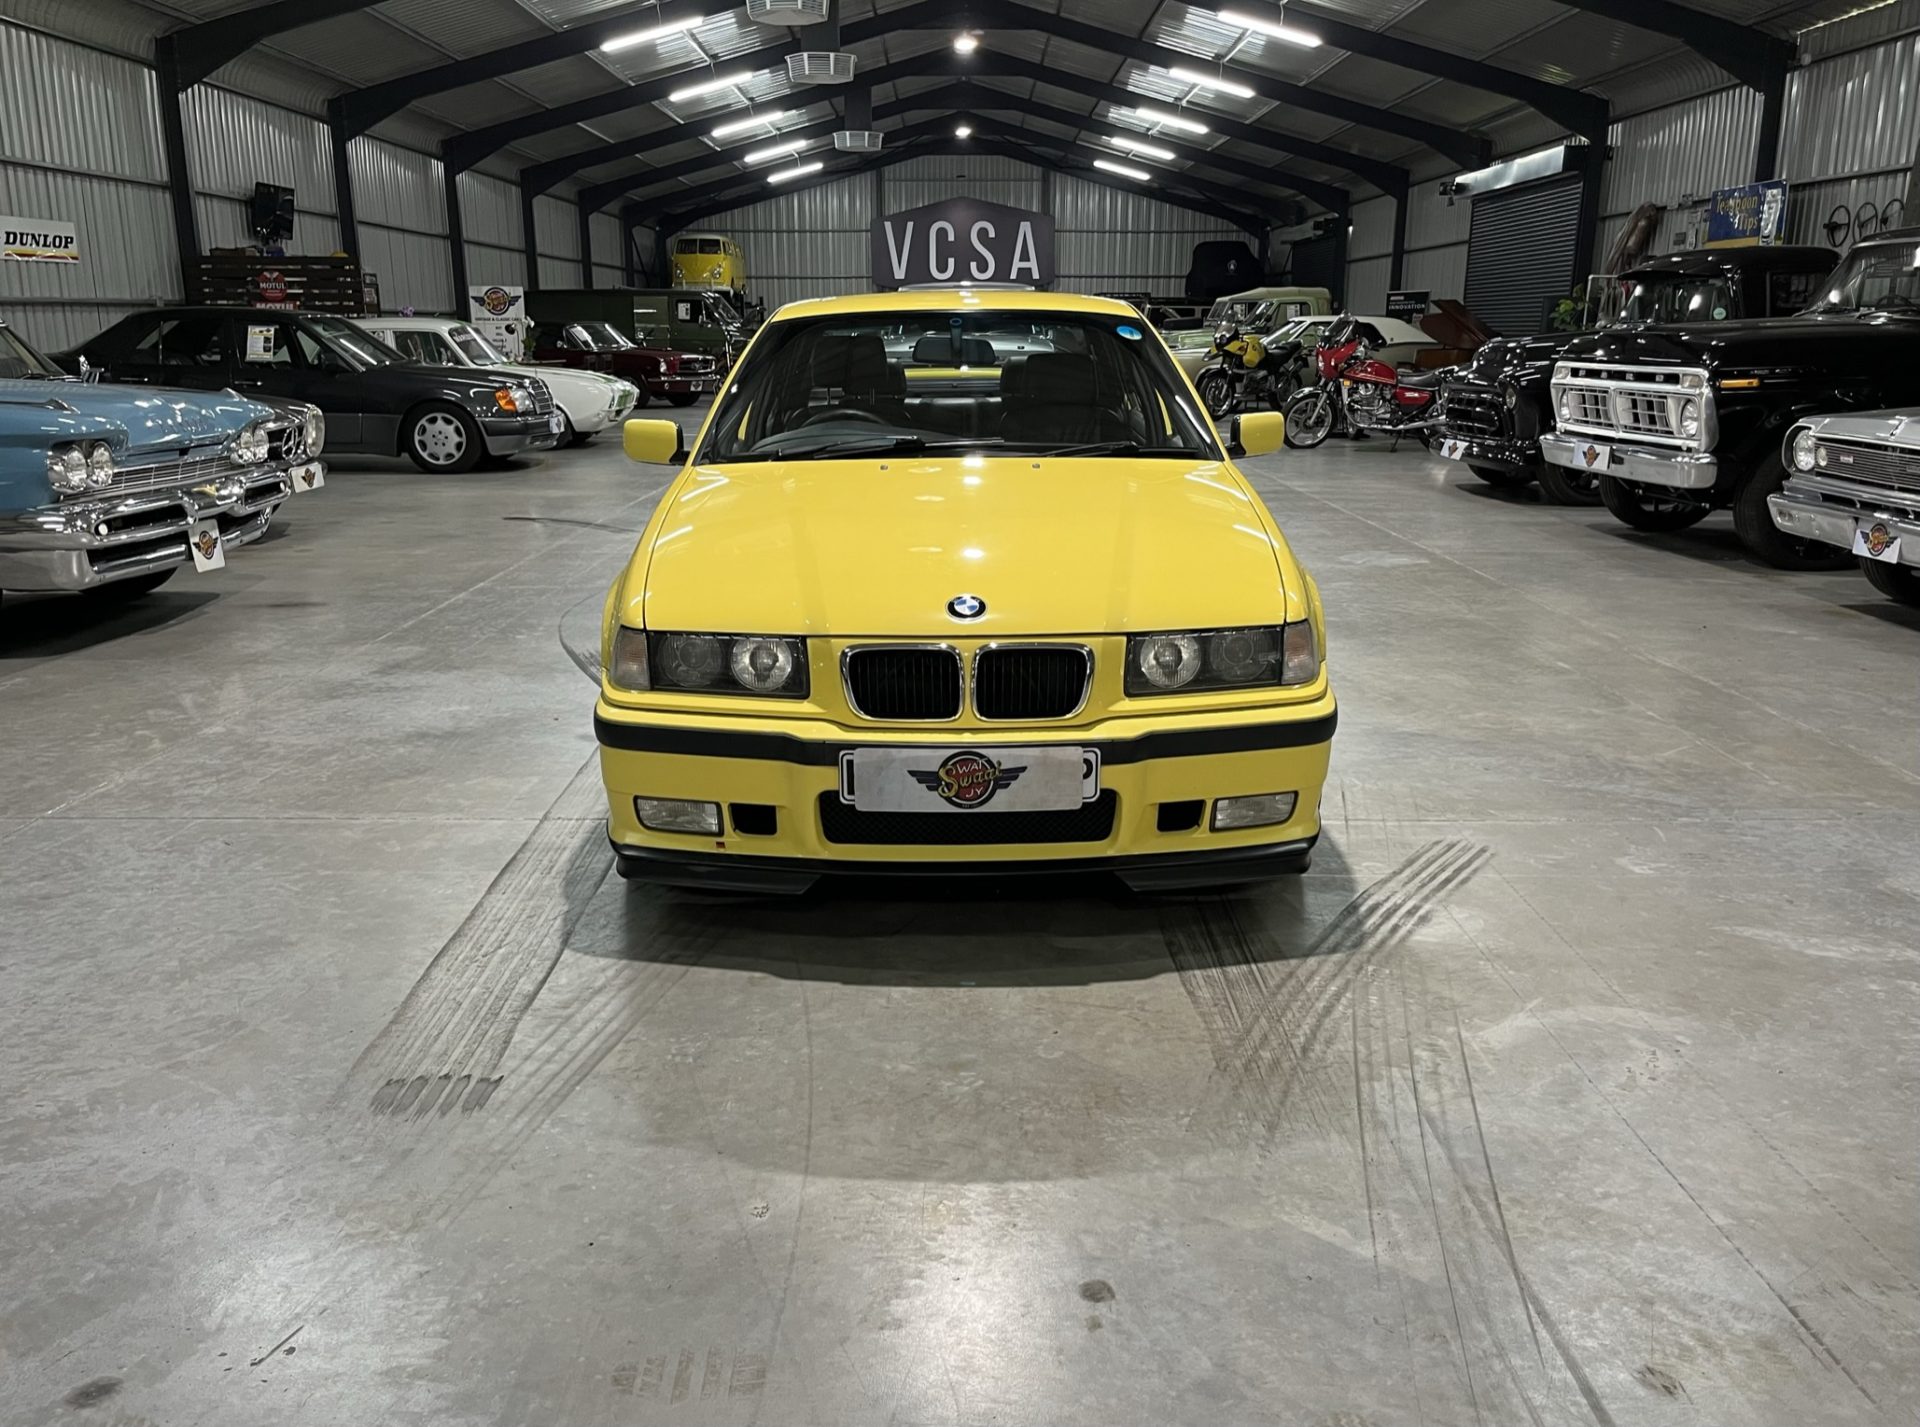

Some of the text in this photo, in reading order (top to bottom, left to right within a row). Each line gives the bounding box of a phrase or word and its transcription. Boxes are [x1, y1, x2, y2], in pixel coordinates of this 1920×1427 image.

[1738, 212, 1759, 235] Tips
[4, 231, 74, 248] DUNLOP
[883, 220, 1040, 280] VCSA
[1578, 369, 1664, 382] FORD
[937, 760, 1003, 798] Swaai
[965, 787, 984, 798] JY
